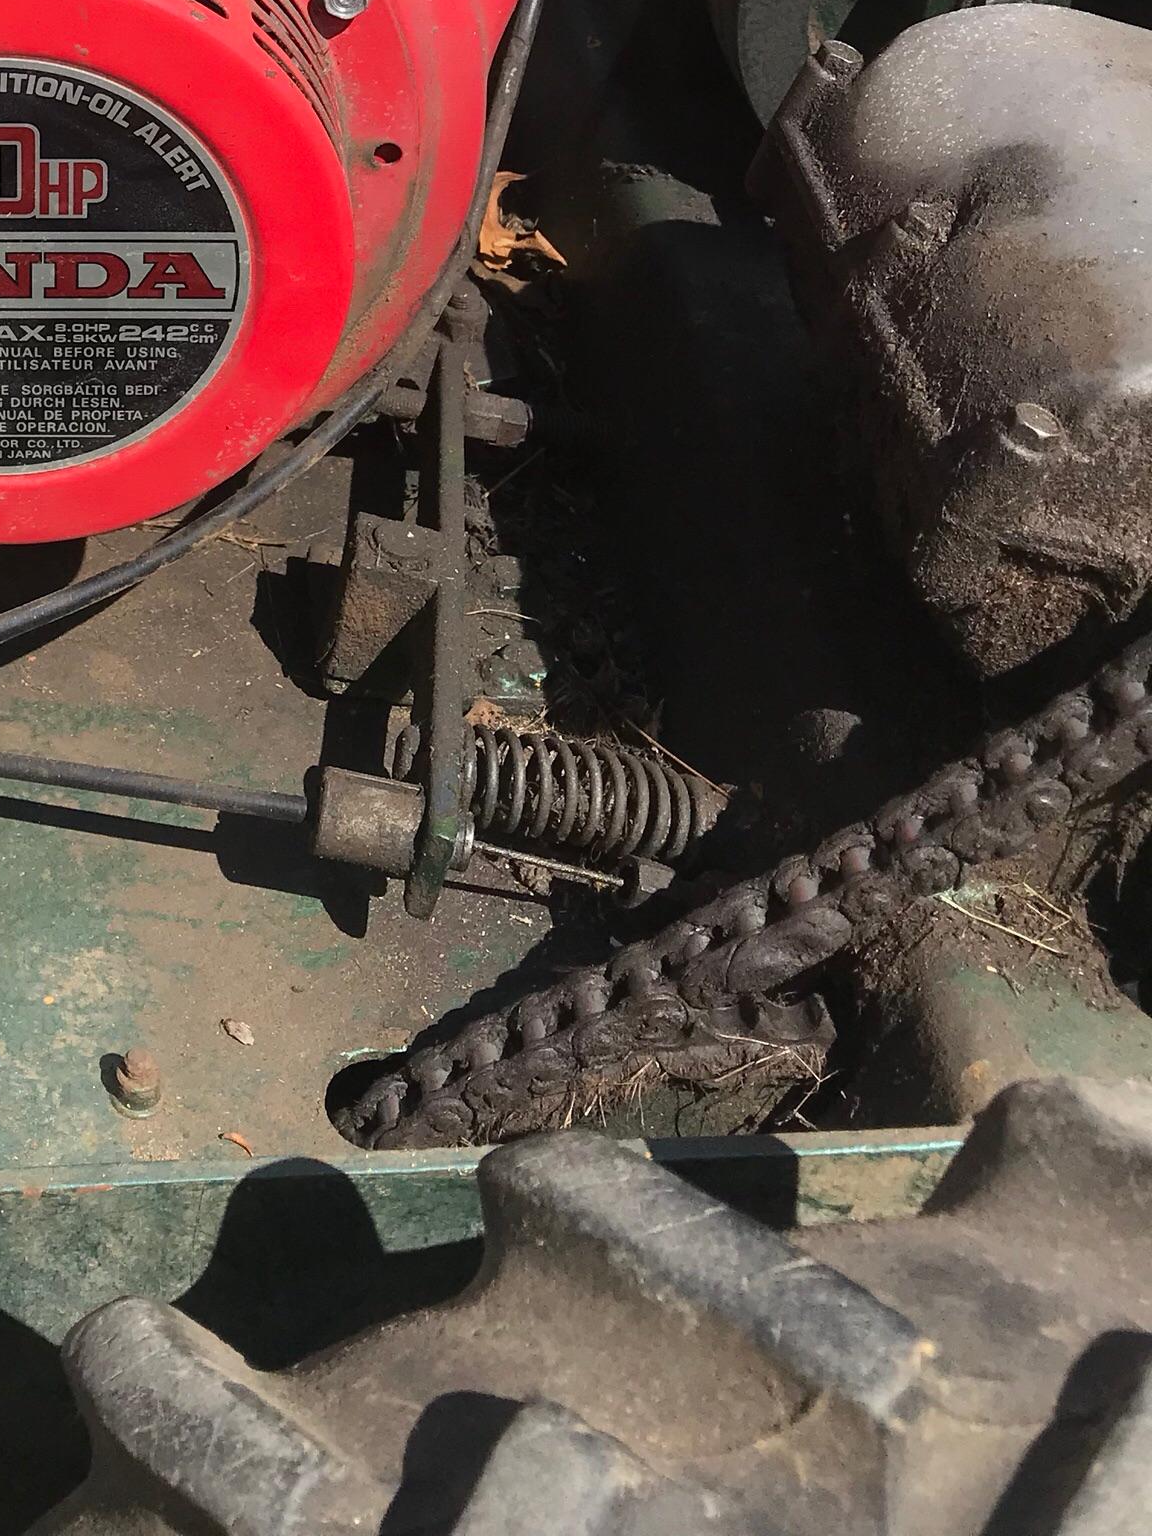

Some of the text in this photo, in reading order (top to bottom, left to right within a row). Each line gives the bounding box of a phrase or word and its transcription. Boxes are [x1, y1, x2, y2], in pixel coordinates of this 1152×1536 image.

[133, 120, 212, 193] ALERT
[54, 323, 110, 332] 8.0HP
[54, 334, 118, 343] 5.9KW
[119, 325, 189, 342] 242
[53, 347, 115, 358] BEFORE
[104, 359, 158, 370] AVANT
[11, 397, 65, 408] DURCH
[72, 397, 125, 408] LESEN.
[44, 410, 63, 420] DE
[7, 450, 51, 459] JAPAN
